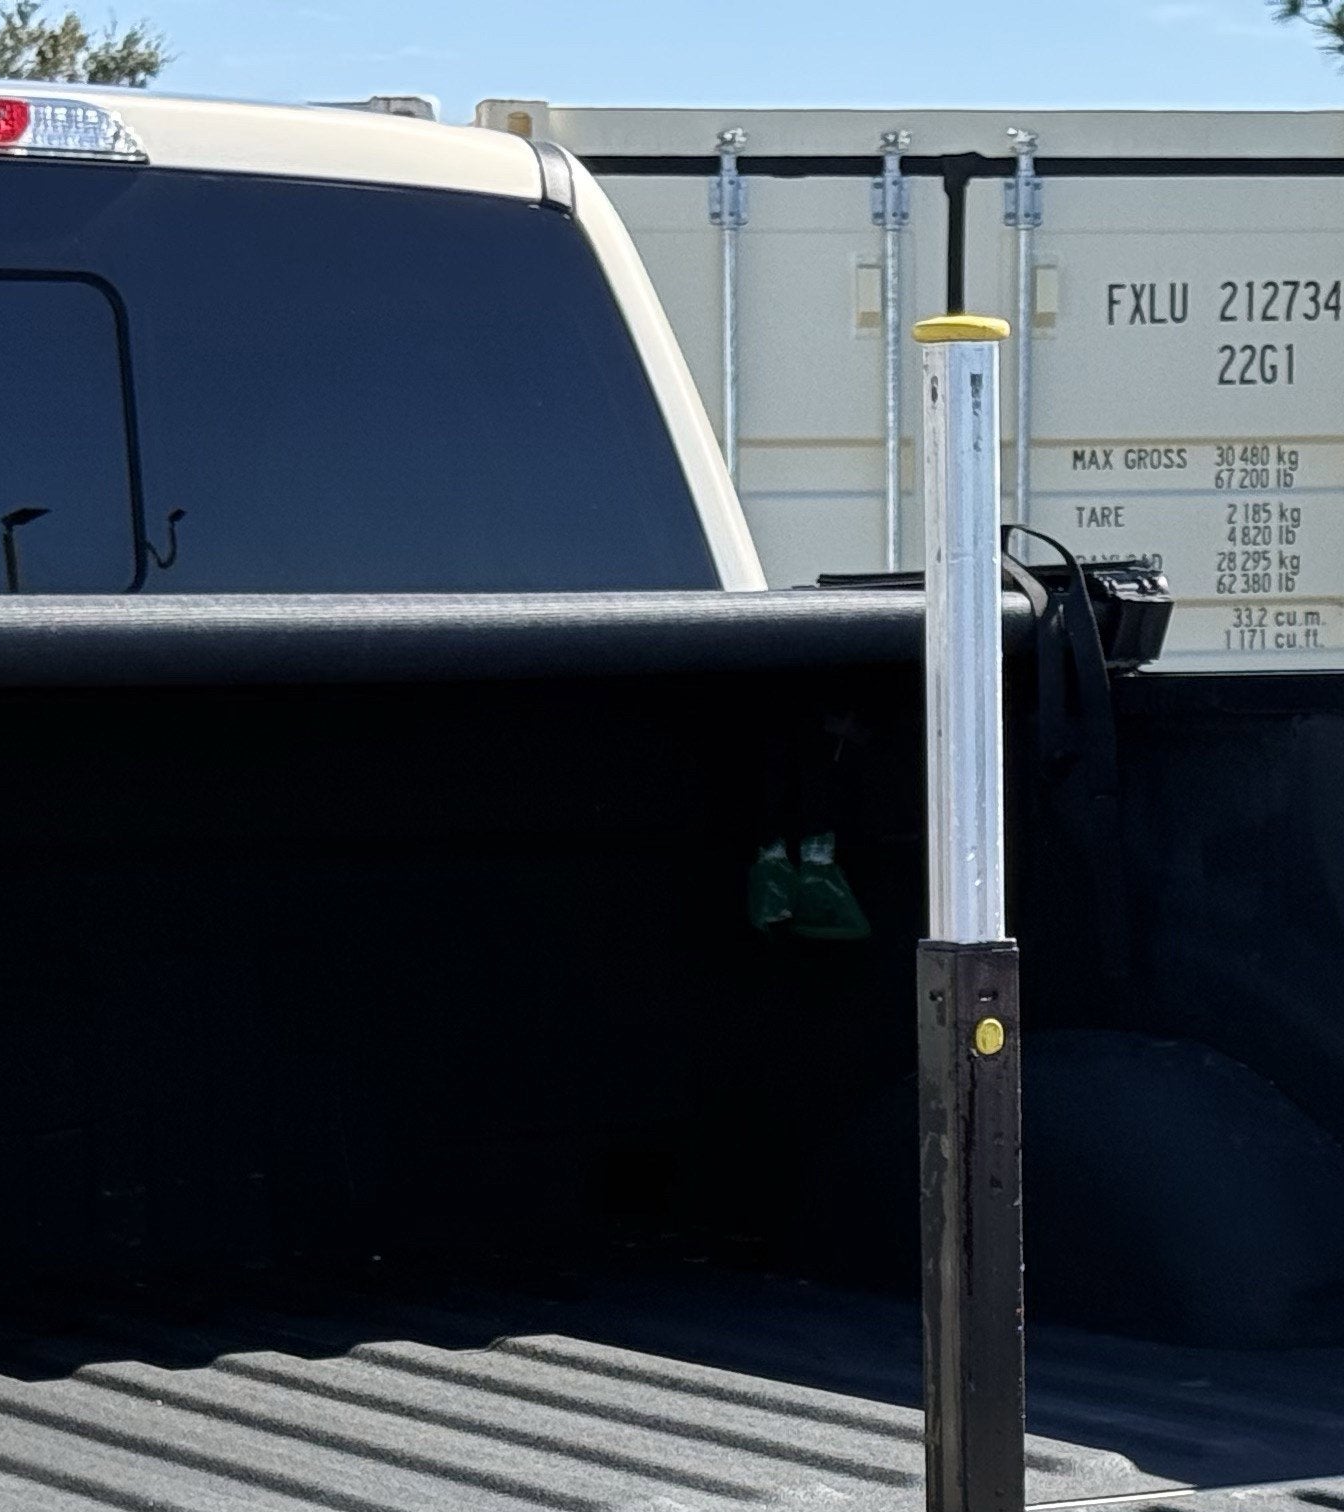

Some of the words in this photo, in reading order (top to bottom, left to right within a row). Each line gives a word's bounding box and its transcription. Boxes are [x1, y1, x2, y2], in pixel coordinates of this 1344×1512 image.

[1107, 282, 1189, 325] FXLU
[1219, 279, 1341, 322] 212734
[1217, 343, 1295, 385] 22G1
[1072, 449, 1114, 471] MAX
[1123, 447, 1187, 470] GROSS
[1275, 444, 1299, 471] kg
[1275, 468, 1295, 488] lb
[1075, 505, 1126, 528] TARE
[1278, 501, 1301, 528] kg
[1278, 525, 1296, 545] lb
[1278, 549, 1301, 576] kg
[1277, 572, 1296, 593] lb
